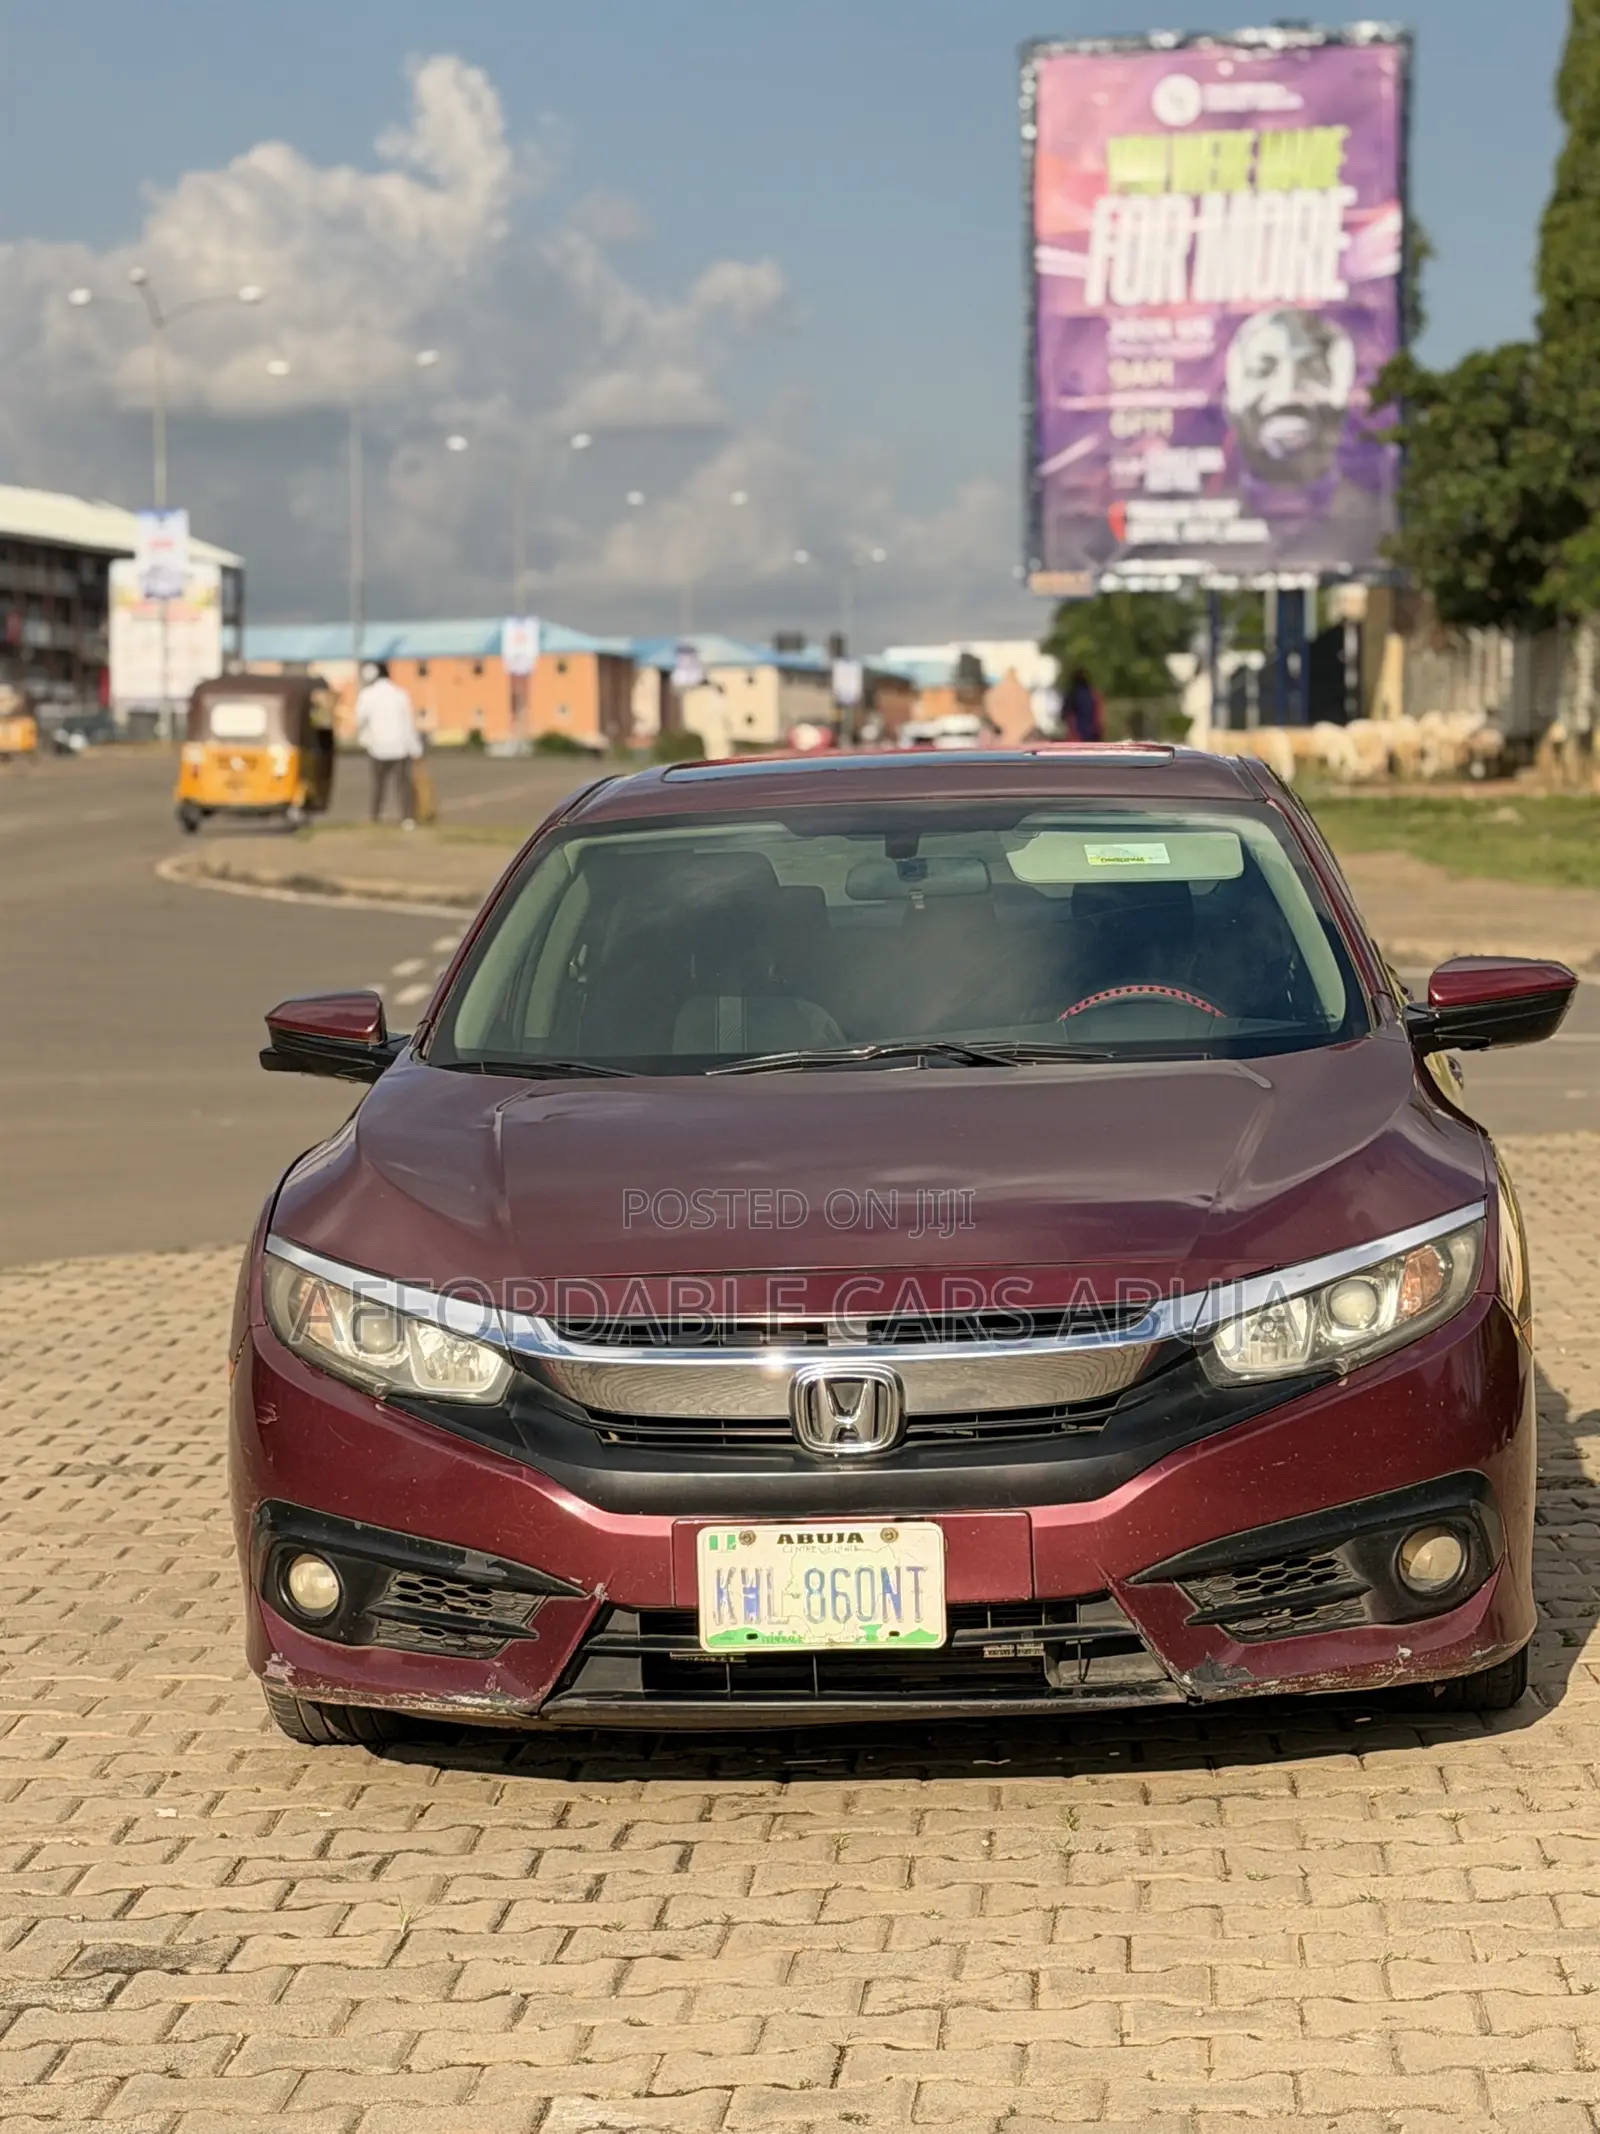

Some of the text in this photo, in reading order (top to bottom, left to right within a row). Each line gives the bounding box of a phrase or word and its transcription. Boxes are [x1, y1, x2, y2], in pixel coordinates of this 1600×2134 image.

[1085, 187, 1358, 306] FOR MORE
[776, 1532, 865, 1545] ABUJA
